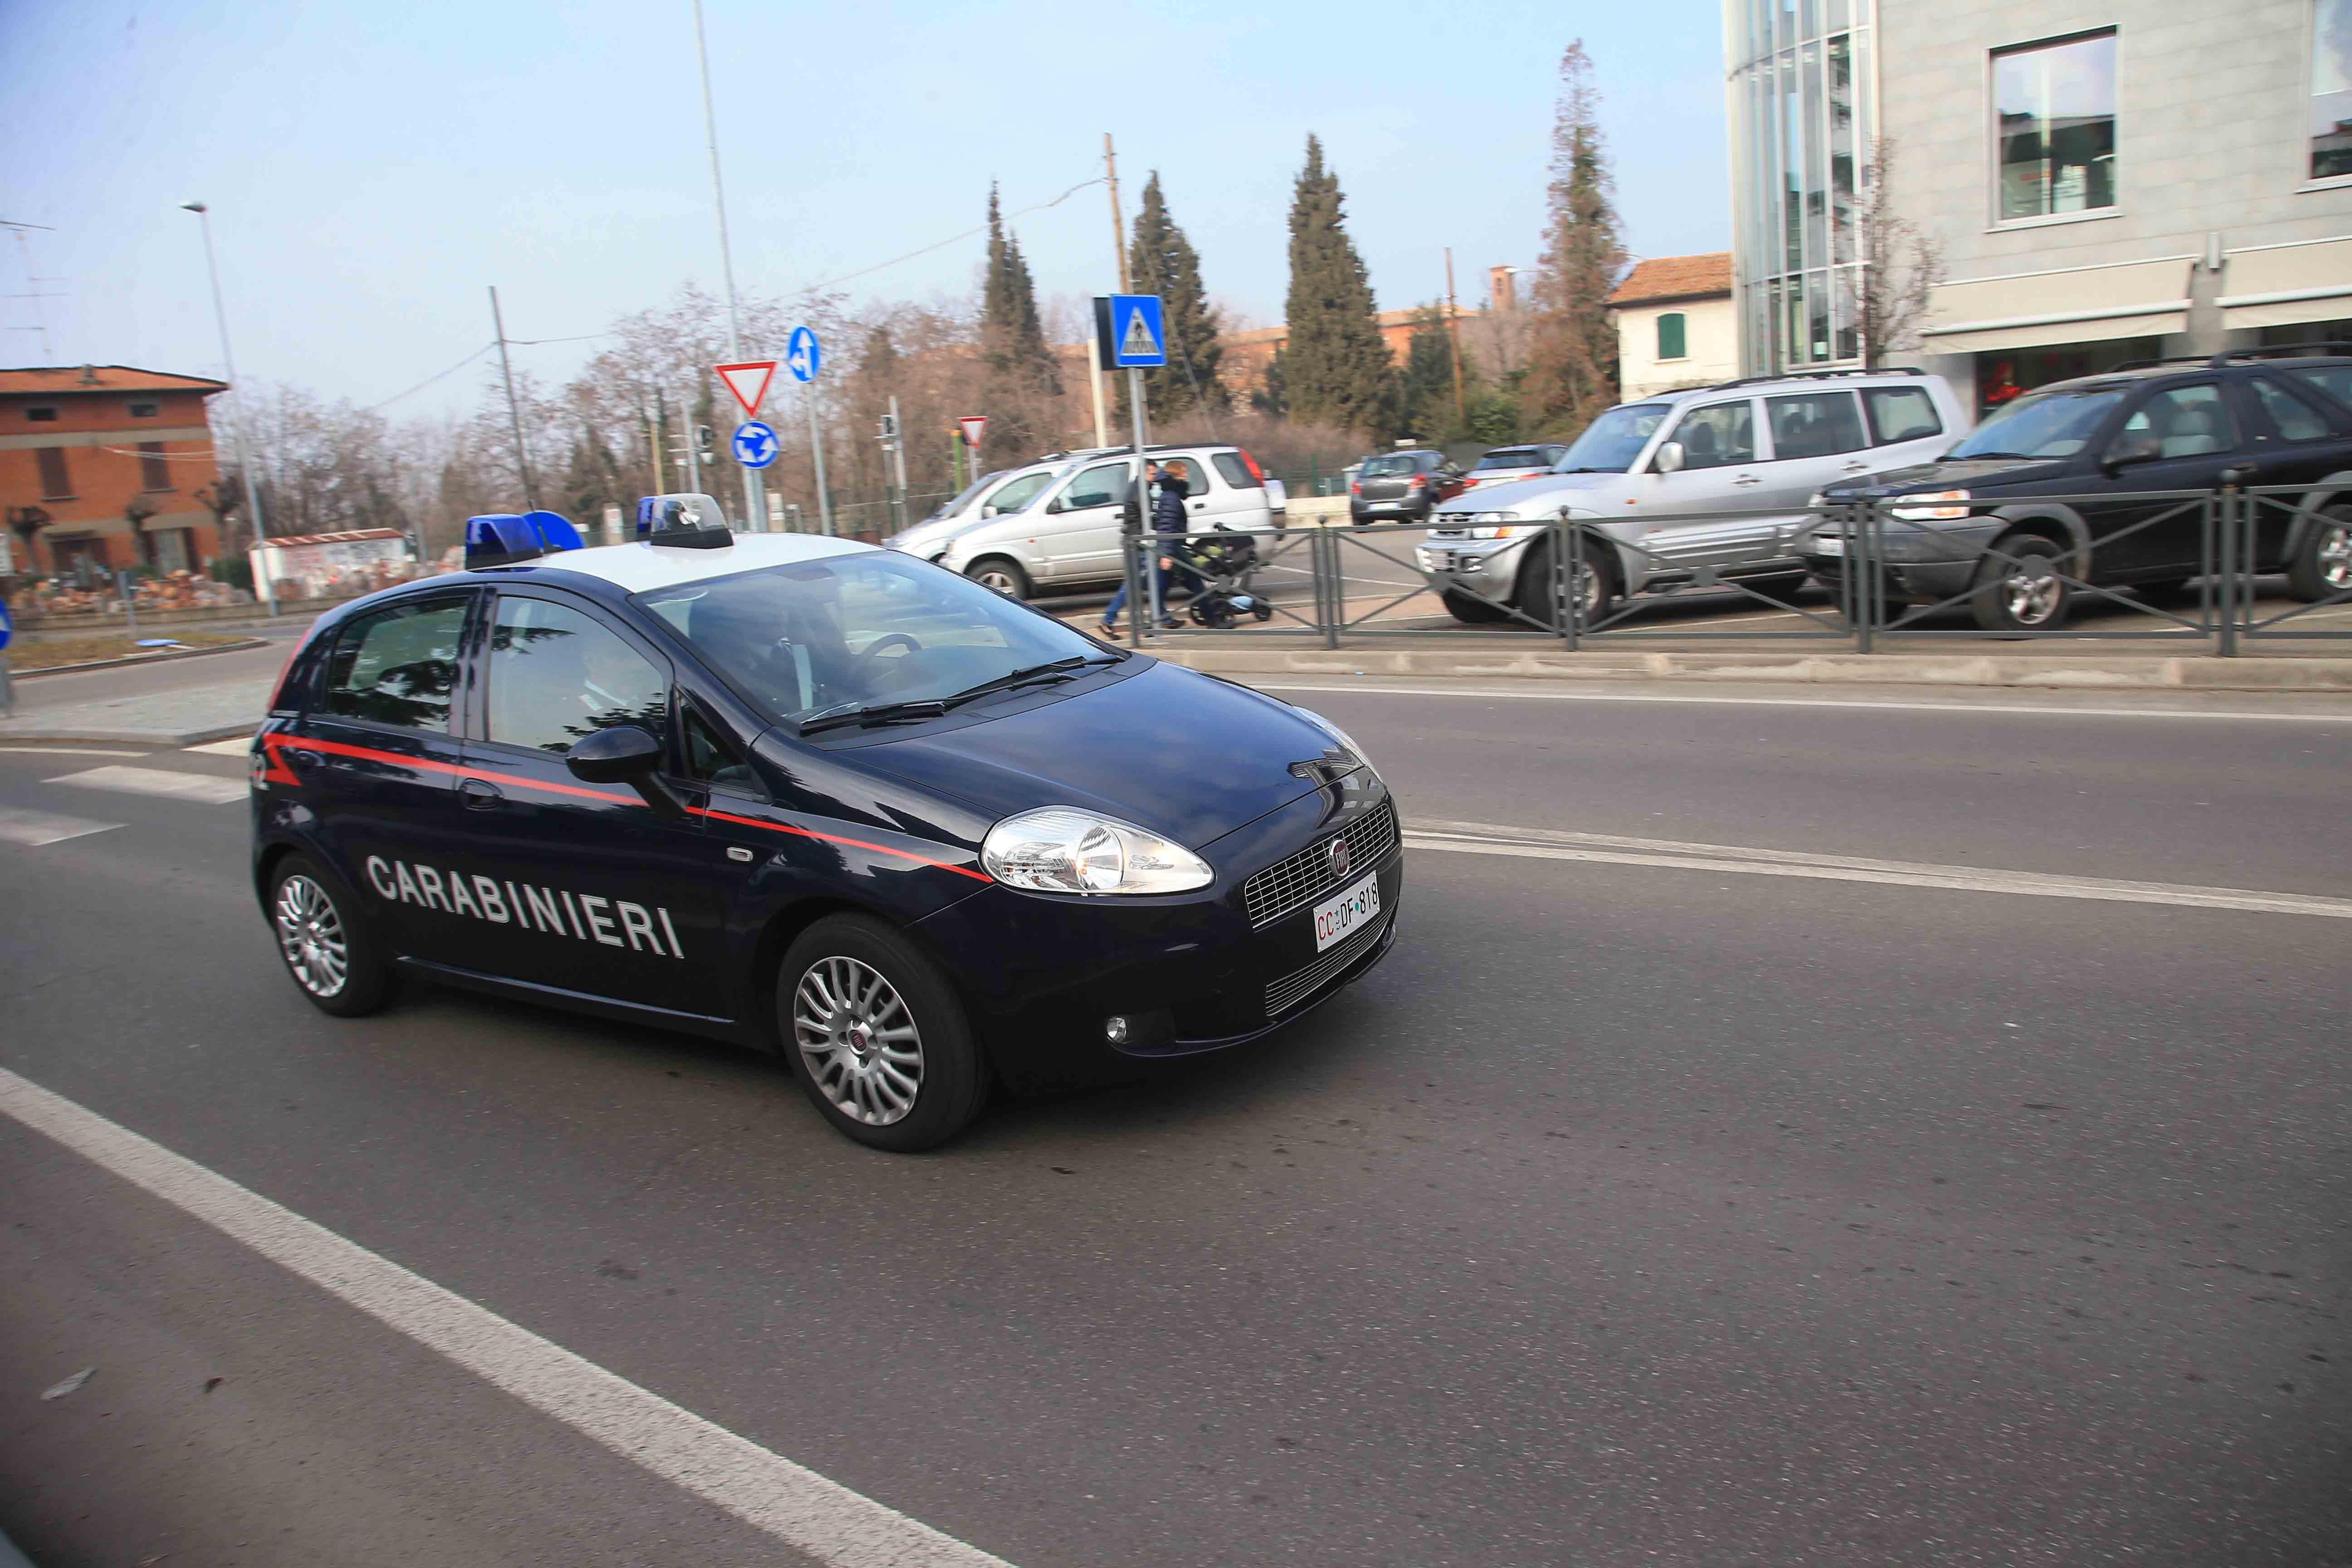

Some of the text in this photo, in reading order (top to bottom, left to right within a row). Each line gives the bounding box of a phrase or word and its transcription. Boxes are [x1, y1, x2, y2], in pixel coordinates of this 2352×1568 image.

[1335, 849, 1347, 869] FIAT
[368, 855, 685, 959] CARABINIERI
[1318, 882, 1377, 940] CC DF 818
